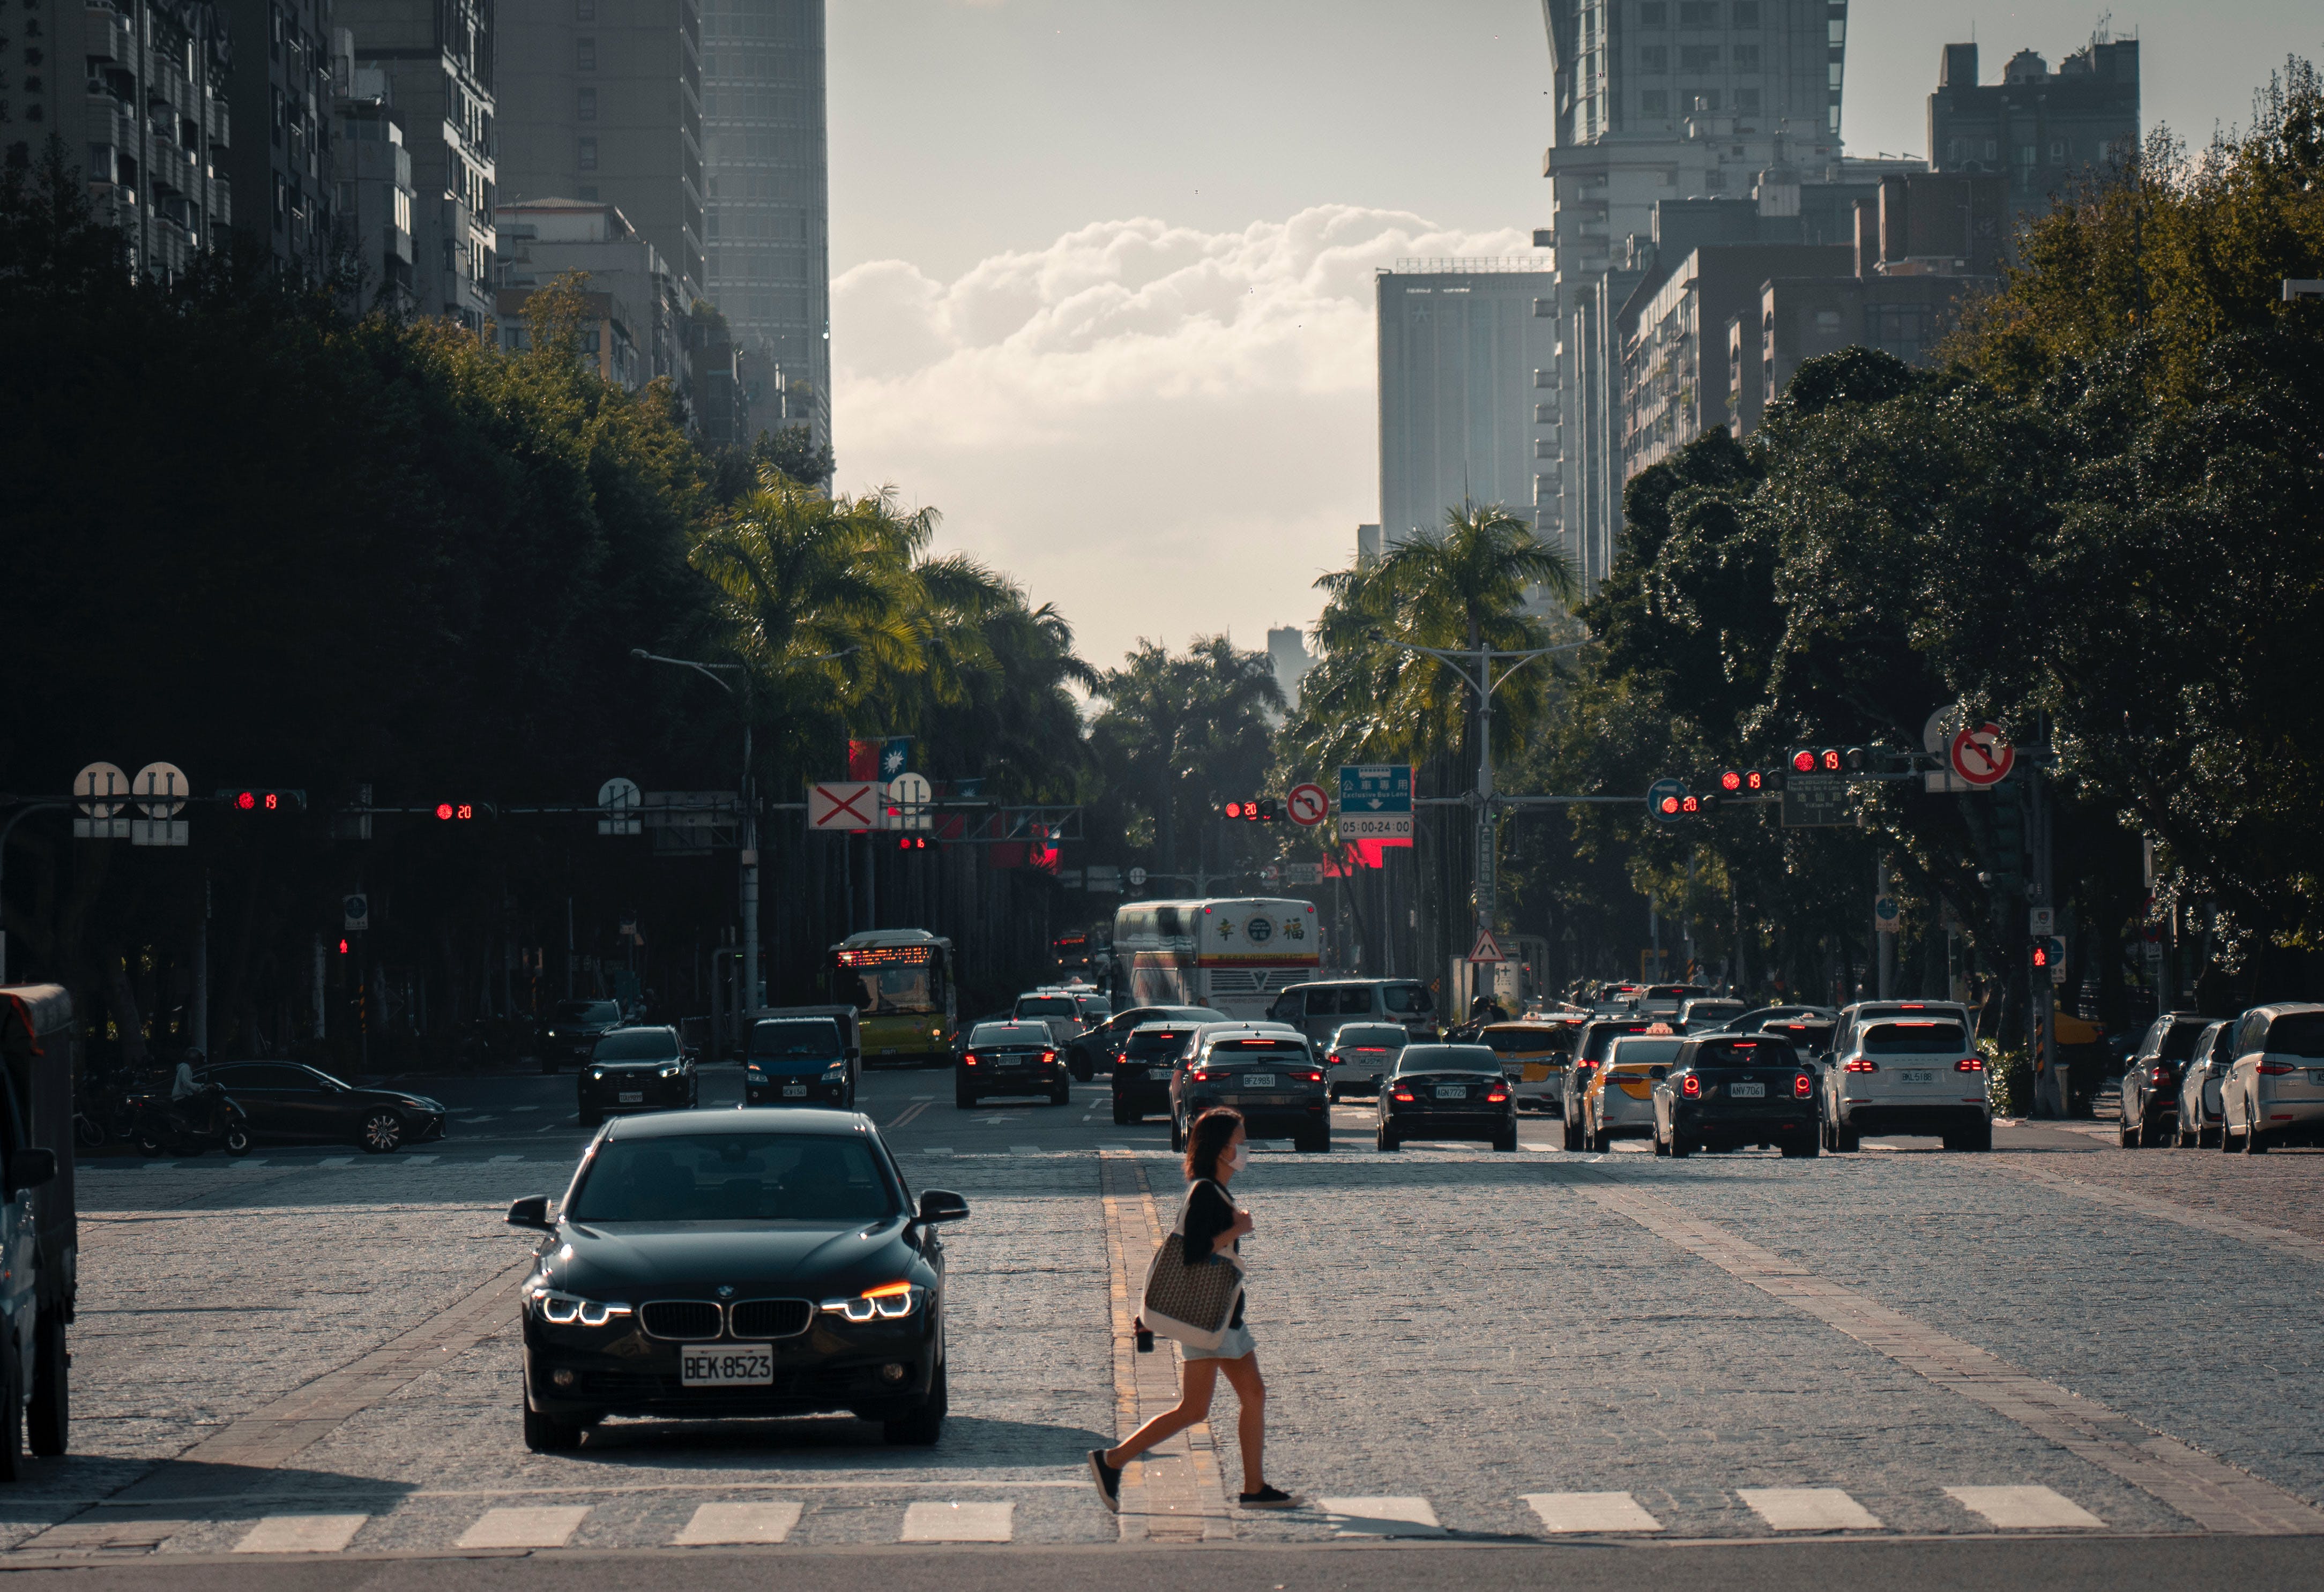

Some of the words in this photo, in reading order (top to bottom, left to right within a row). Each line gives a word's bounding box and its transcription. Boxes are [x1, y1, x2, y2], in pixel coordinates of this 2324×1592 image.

[1826, 752, 1838, 769] 19
[1343, 780, 1408, 790] 公車專用
[1751, 773, 1761, 789] 19
[266, 794, 277, 809] 19
[1684, 797, 1697, 812] 20
[458, 805, 471, 819] 20
[1245, 803, 1257, 816] 20
[1343, 821, 1409, 832] 05:00-24:00
[1217, 918, 1235, 941] 幸
[1283, 917, 1305, 940] 福
